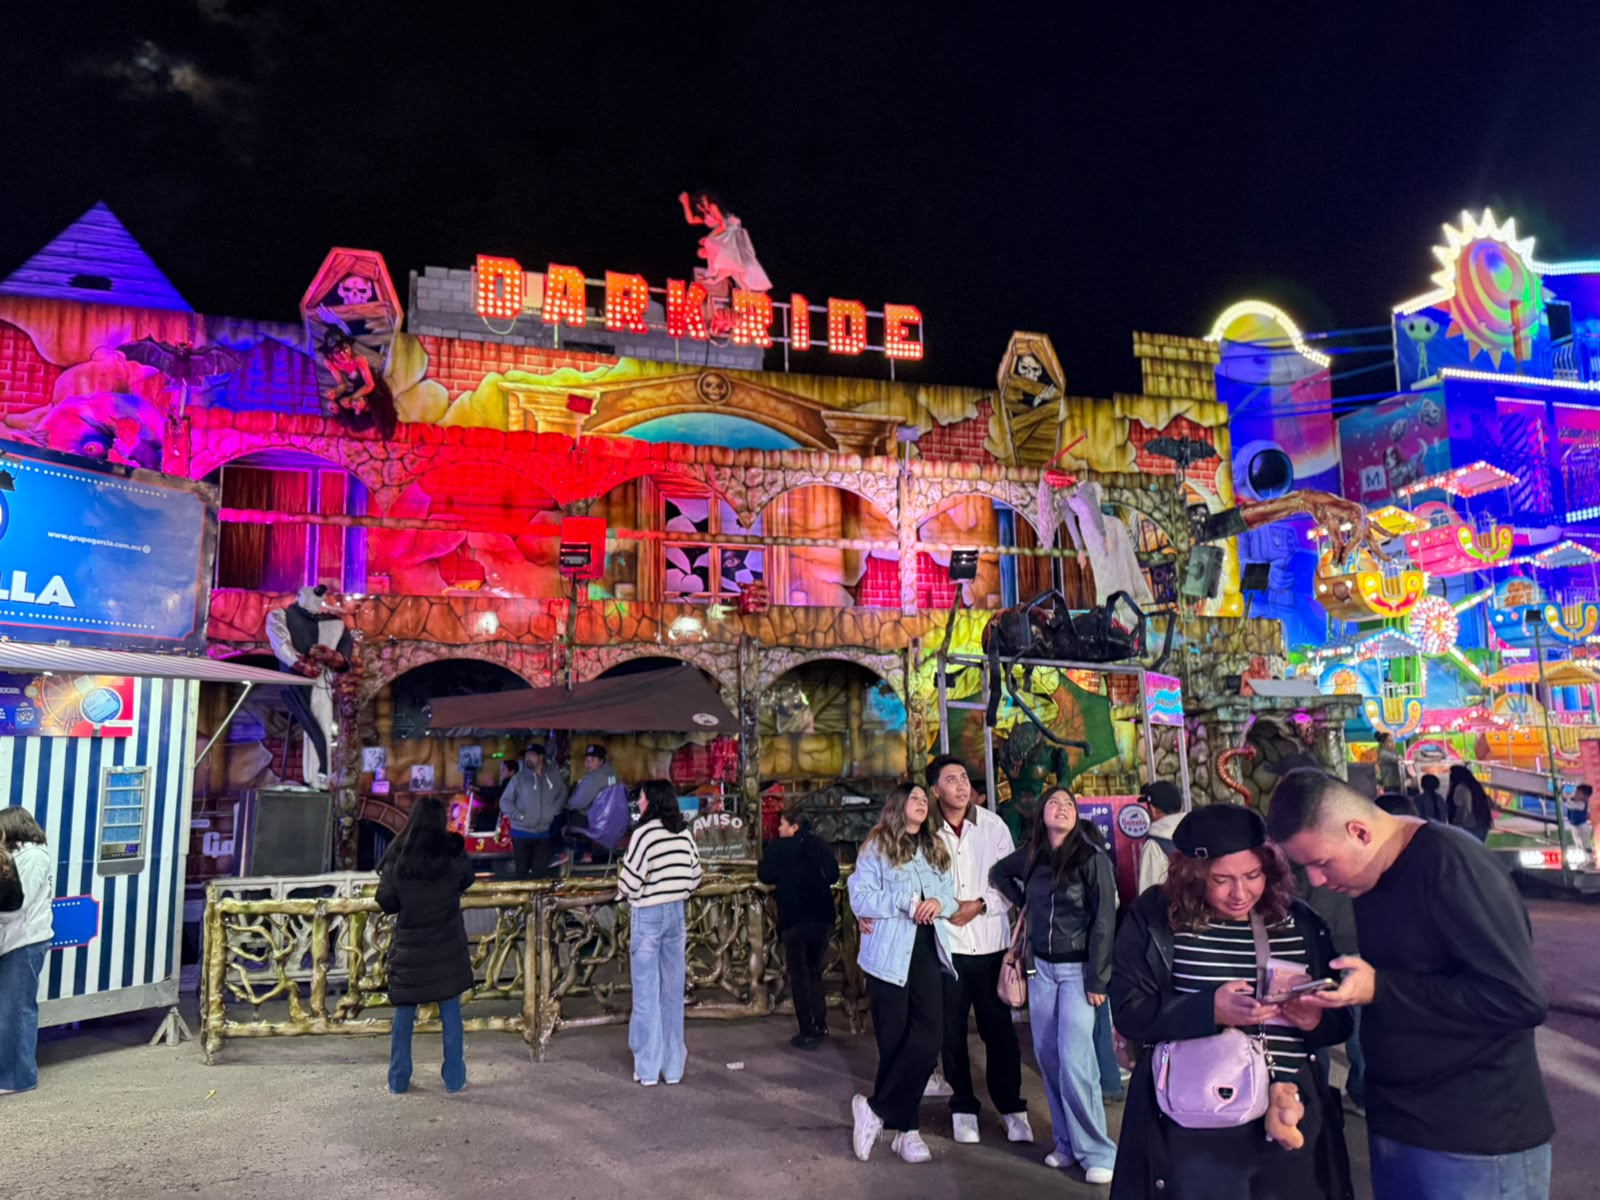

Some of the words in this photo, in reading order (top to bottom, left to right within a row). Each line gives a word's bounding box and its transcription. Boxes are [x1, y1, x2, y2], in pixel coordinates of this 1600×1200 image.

[476, 254, 708, 341] DARK
[731, 288, 923, 361] RIDE
[693, 813, 743, 834] AVISO
[475, 838, 485, 850] 3
